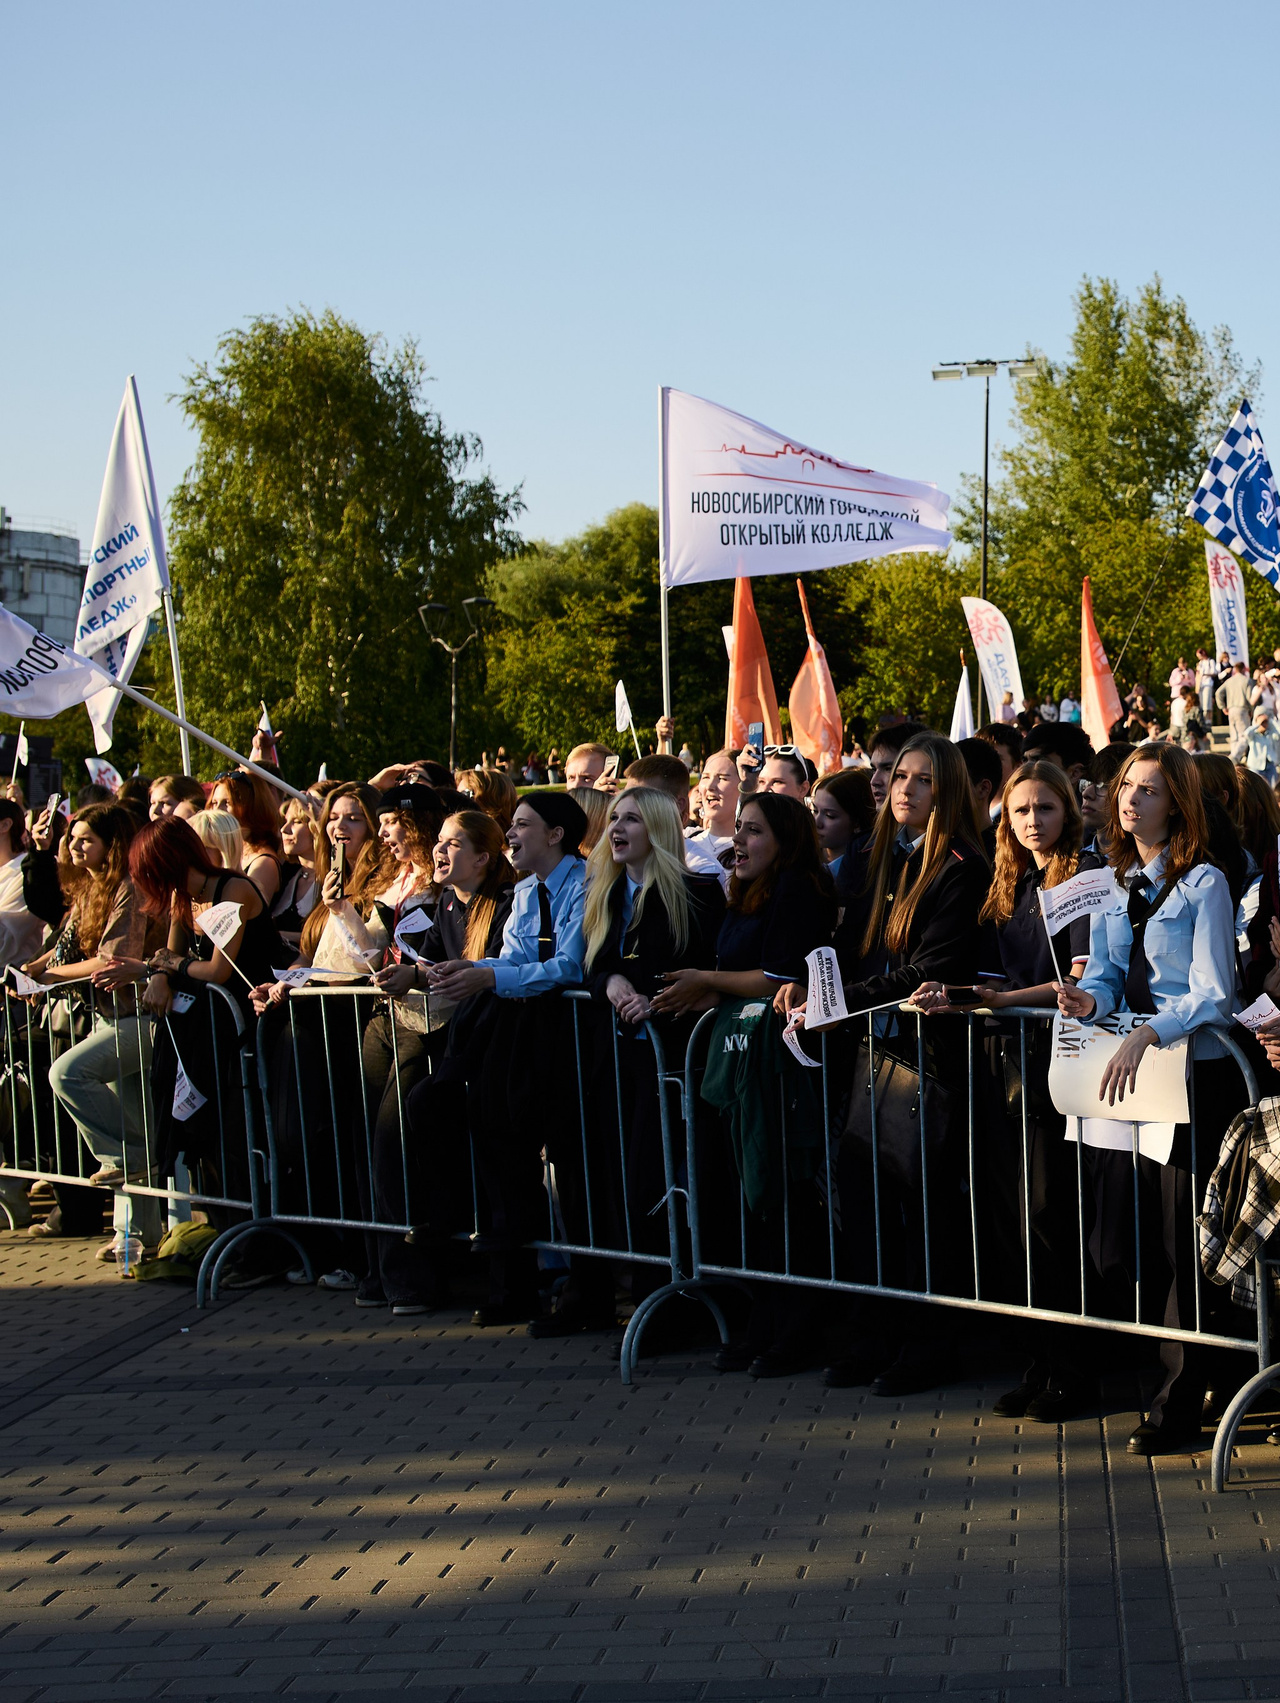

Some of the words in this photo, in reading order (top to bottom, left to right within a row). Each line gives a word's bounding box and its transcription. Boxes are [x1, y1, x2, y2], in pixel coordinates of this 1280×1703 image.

[691, 492, 825, 515] НОВОСИБИРСКИЙ
[720, 519, 805, 546] ОТКРЫТЫЙ
[811, 522, 894, 544] КОЛЛЕДЖ
